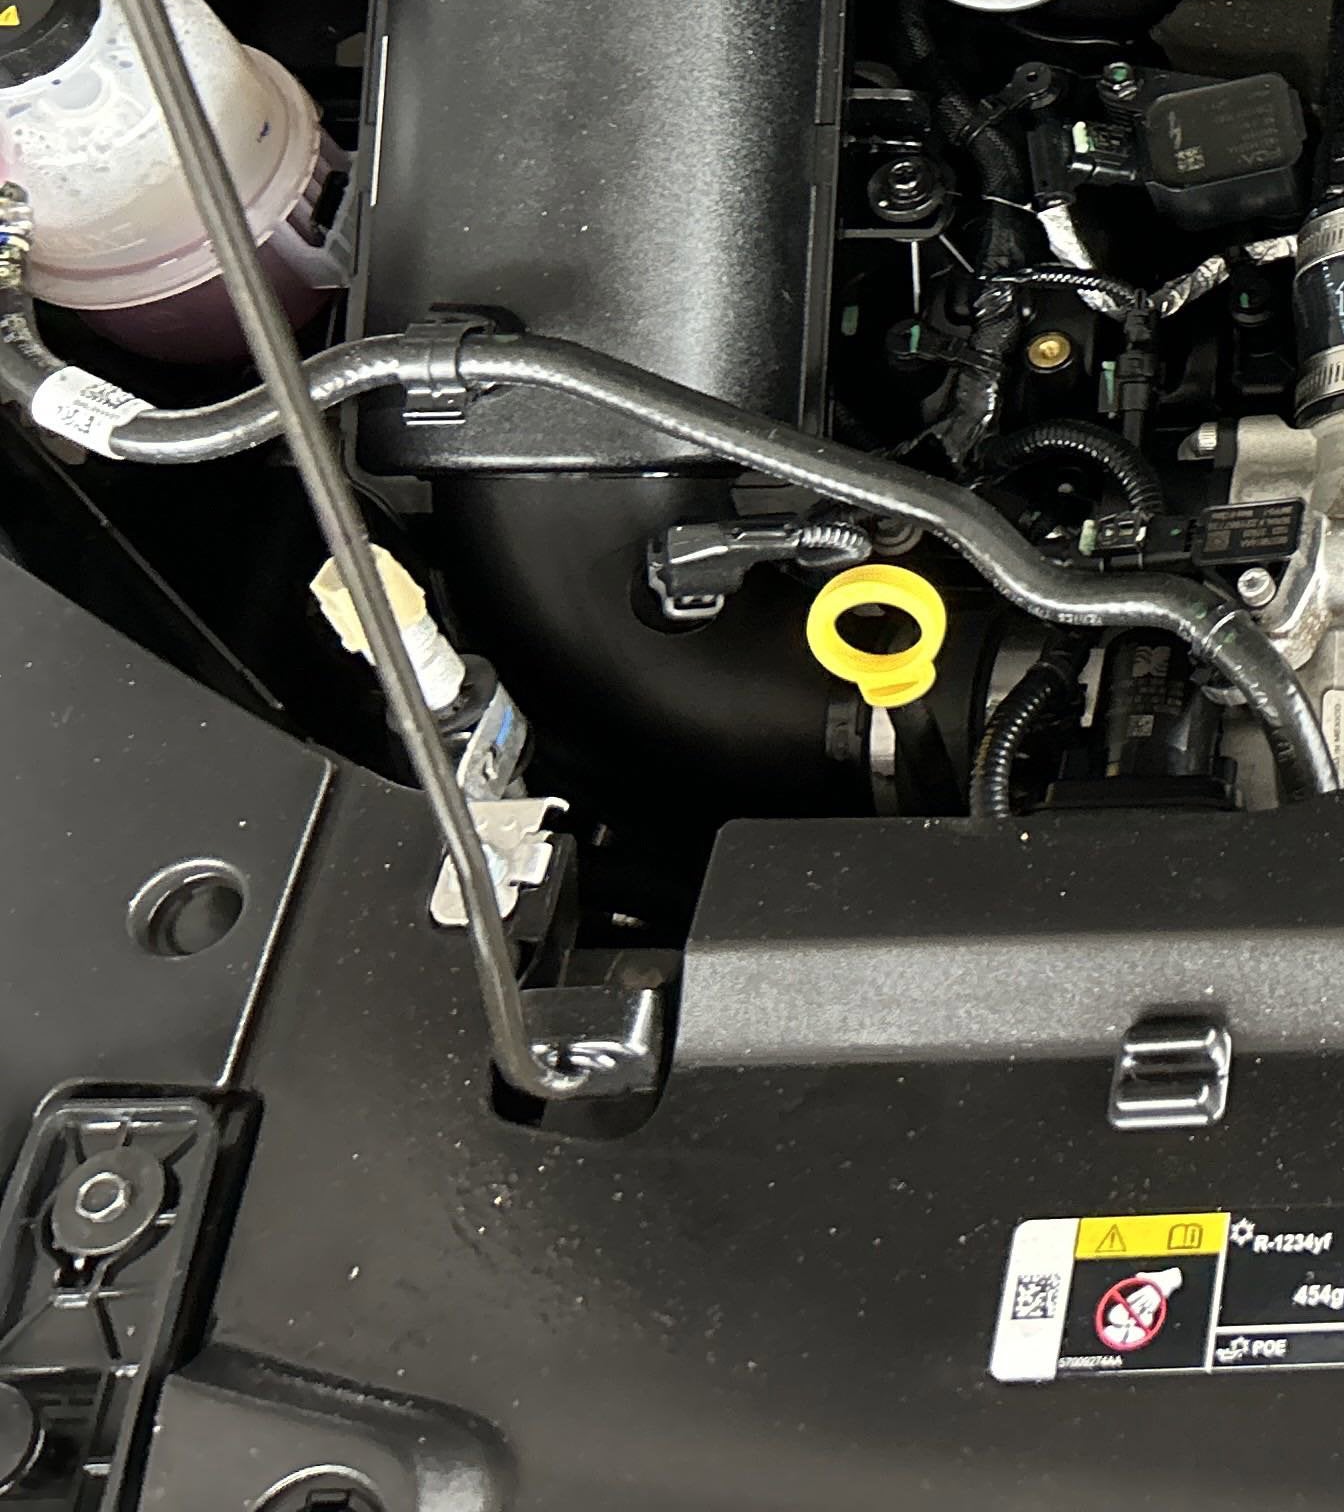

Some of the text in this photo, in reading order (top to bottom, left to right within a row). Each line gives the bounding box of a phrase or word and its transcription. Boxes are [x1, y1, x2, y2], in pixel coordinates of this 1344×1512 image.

[1254, 1233, 1332, 1255] R-1234yf
[1294, 1284, 1344, 1310] 454g
[1251, 1339, 1287, 1357] POE
